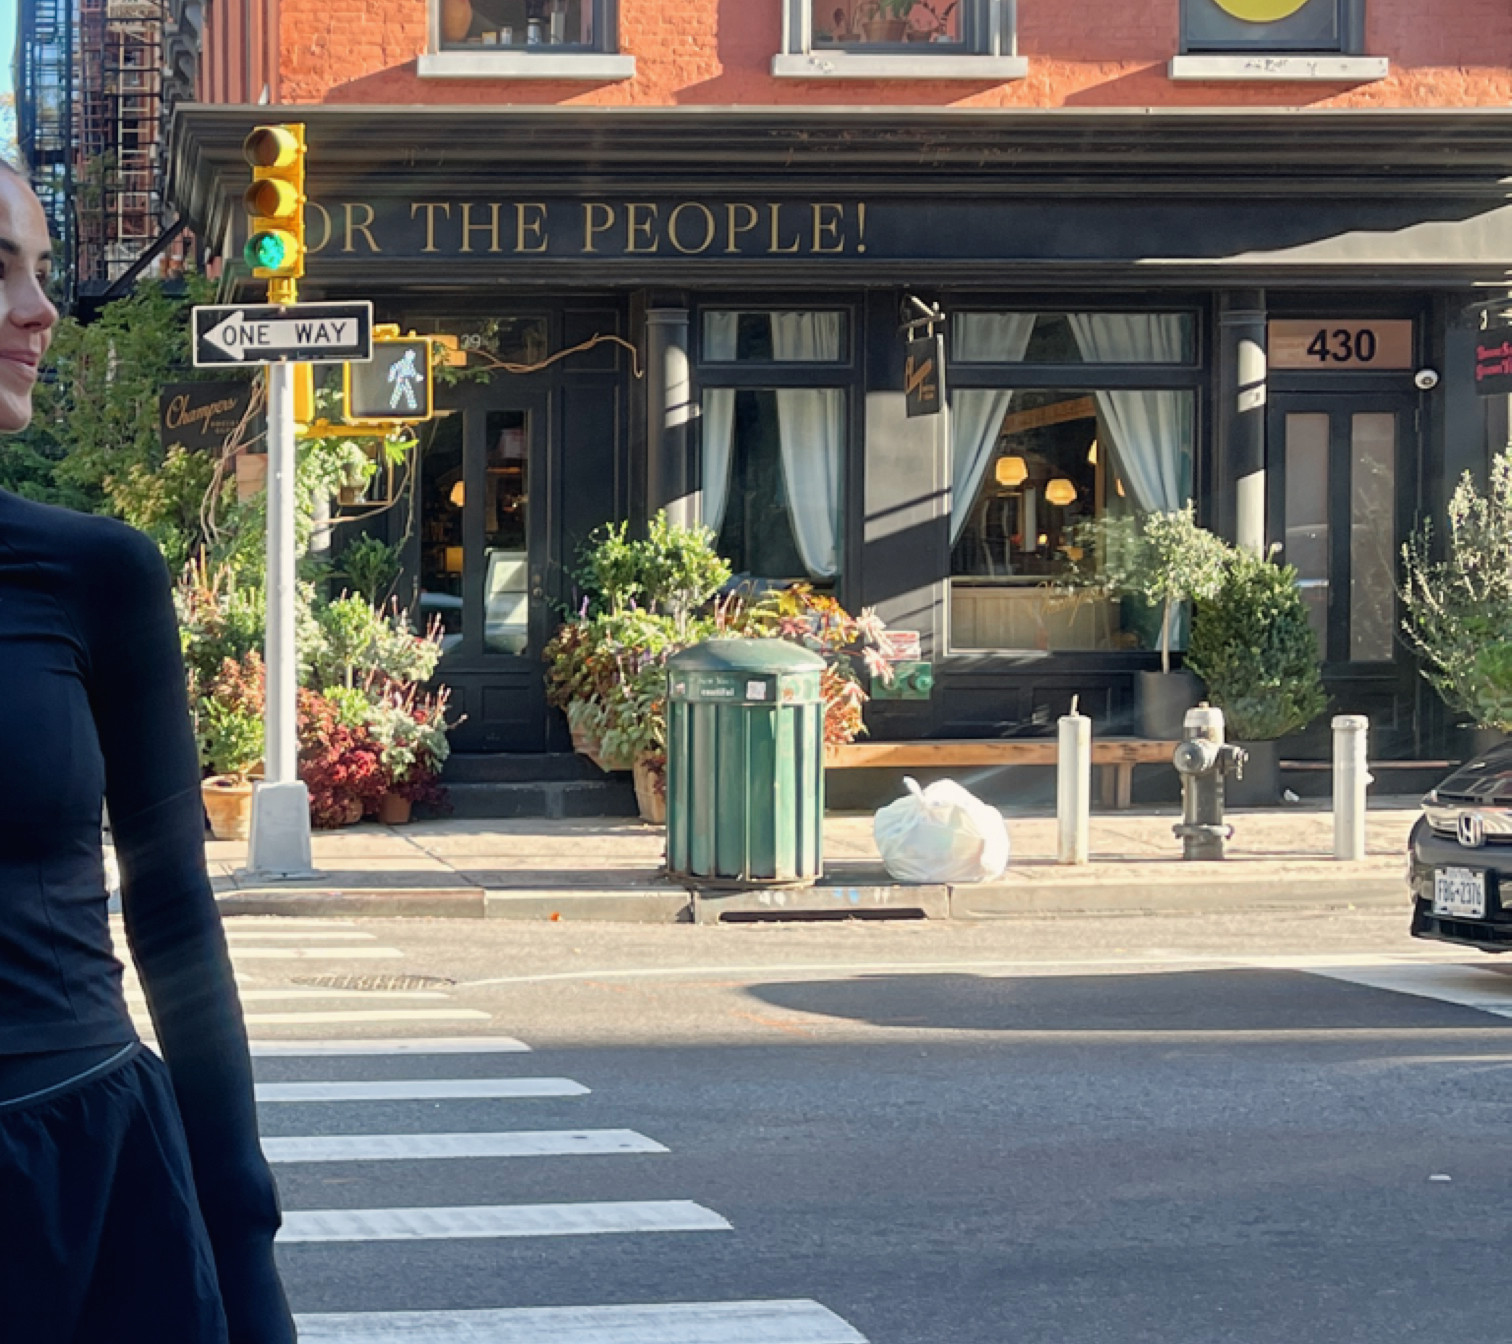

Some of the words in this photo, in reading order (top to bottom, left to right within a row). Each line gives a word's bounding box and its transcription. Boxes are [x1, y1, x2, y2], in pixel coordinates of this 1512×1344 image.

[410, 202, 549, 253] THE
[580, 201, 866, 254] PEOPLE!
[222, 324, 270, 346] ONE
[295, 321, 347, 344] WAY
[1307, 329, 1377, 362] 430
